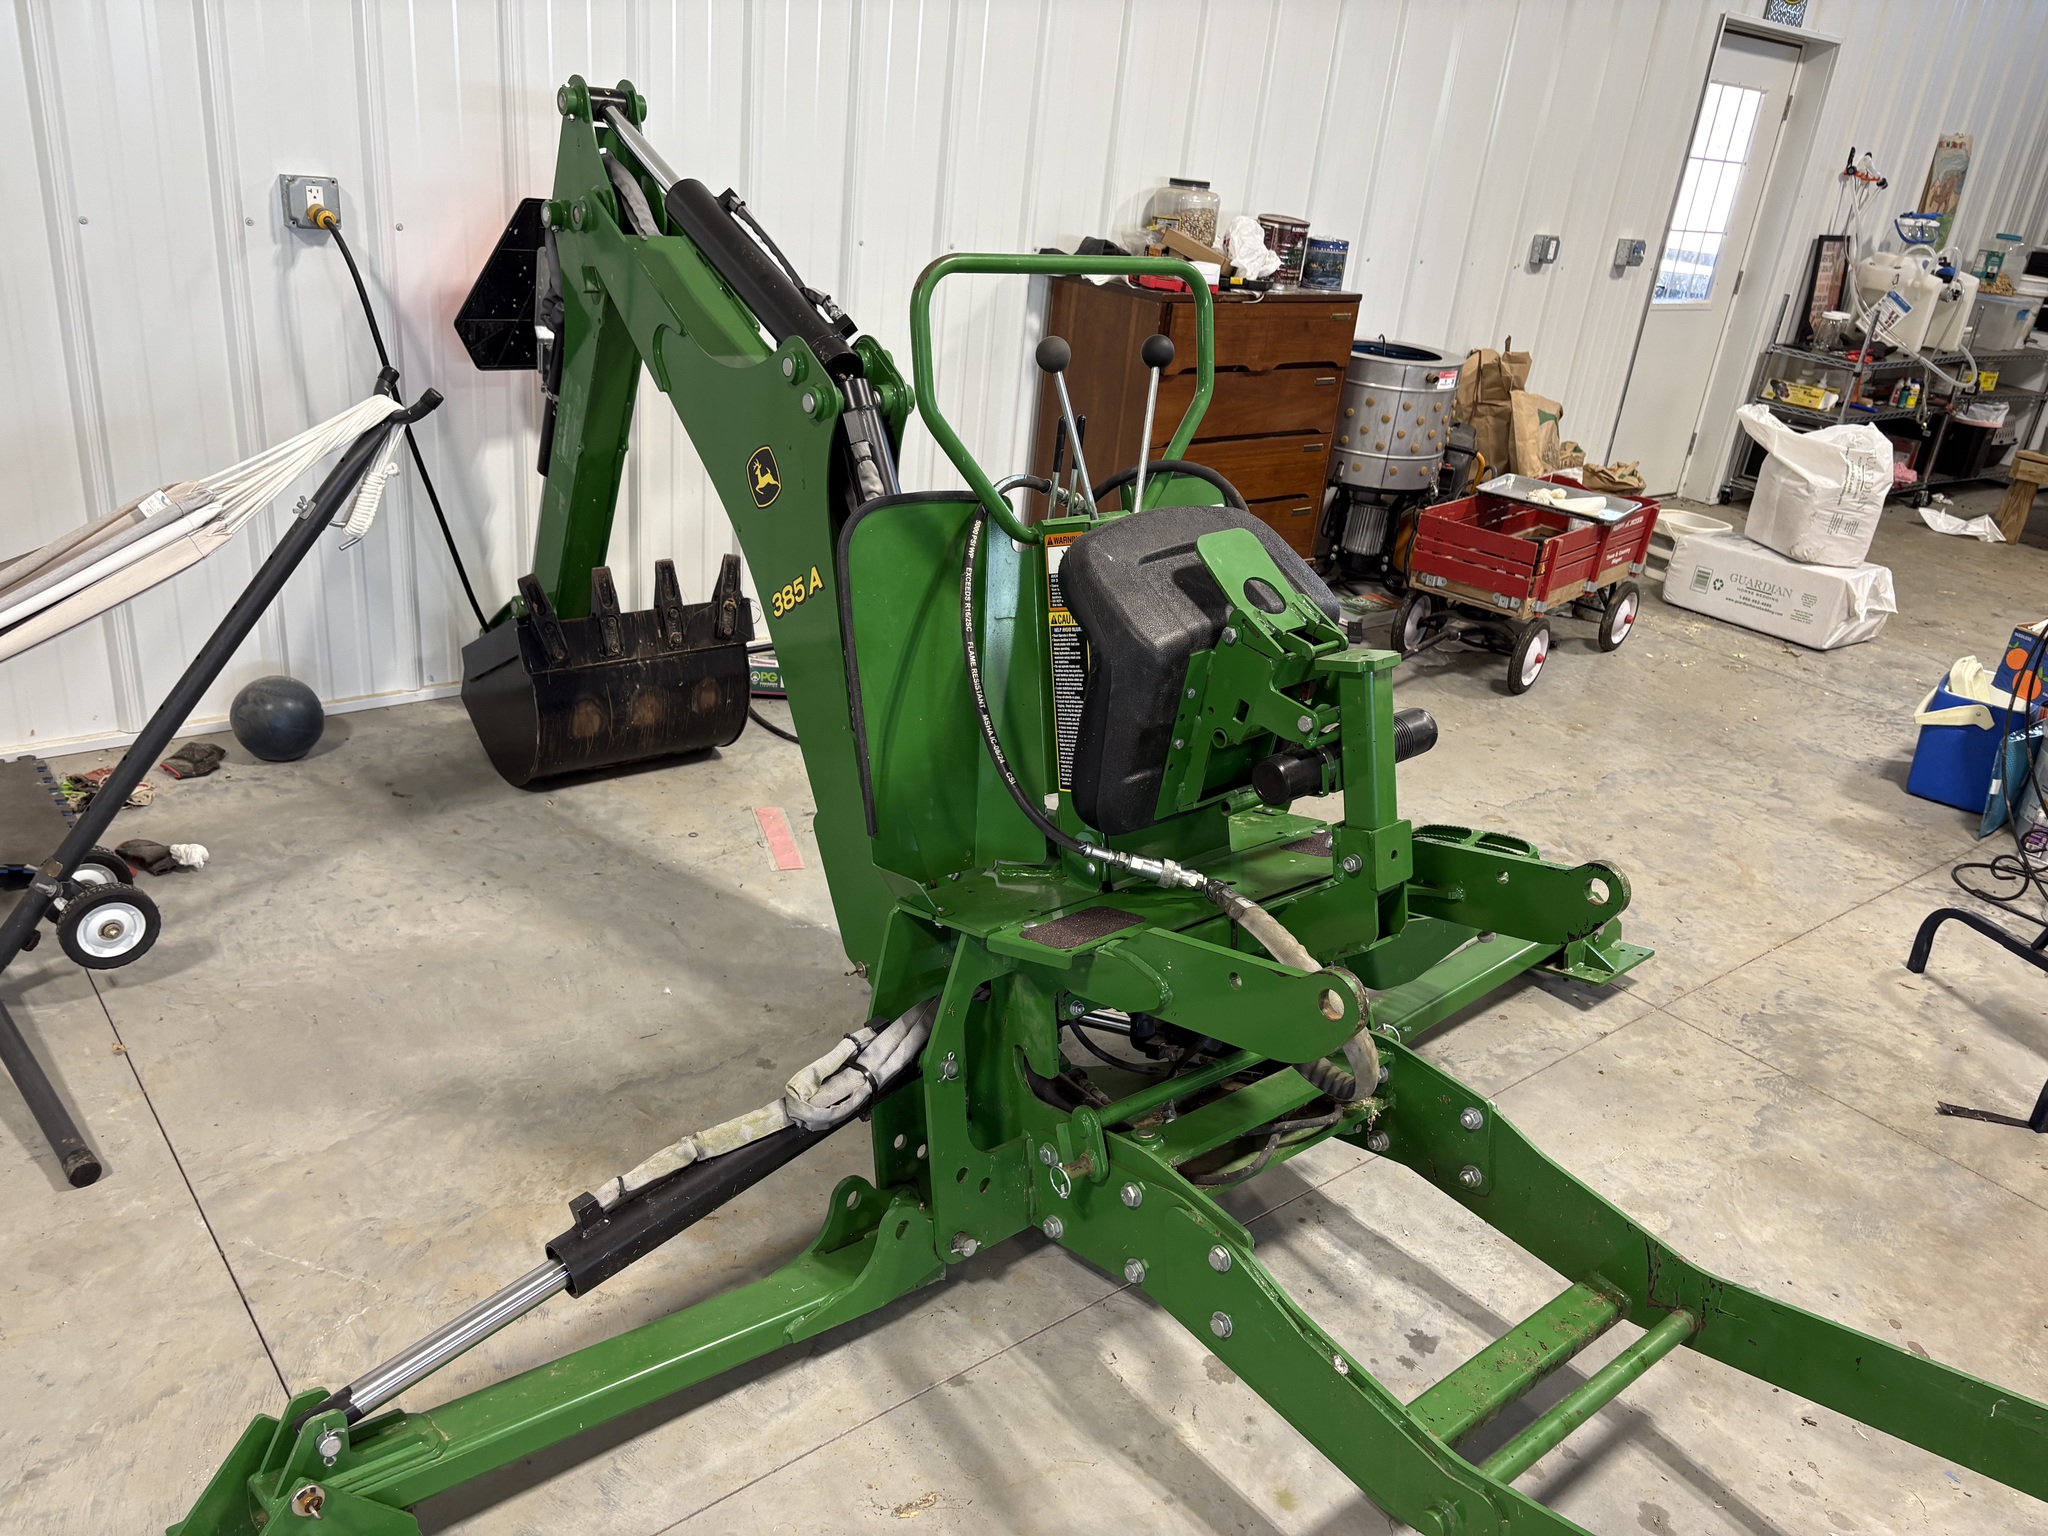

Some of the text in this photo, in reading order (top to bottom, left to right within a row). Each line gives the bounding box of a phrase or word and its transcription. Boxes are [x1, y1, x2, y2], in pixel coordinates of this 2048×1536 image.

[974, 520, 982, 535] 5000
[969, 535, 978, 547] PSI
[1054, 536, 1078, 545] WARNIN
[968, 547, 976, 559] WP
[771, 565, 825, 618] 385 A
[964, 567, 973, 600] EXCEEDS
[1729, 573, 1793, 598] GUARDIAN
[1737, 587, 1779, 603] HORSE BEDDING
[967, 641, 977, 666] FLAME
[760, 671, 778, 683] PG
[971, 668, 987, 709] RESISTANT
[982, 714, 994, 735] MSHA
[1006, 771, 1017, 785] CSI
